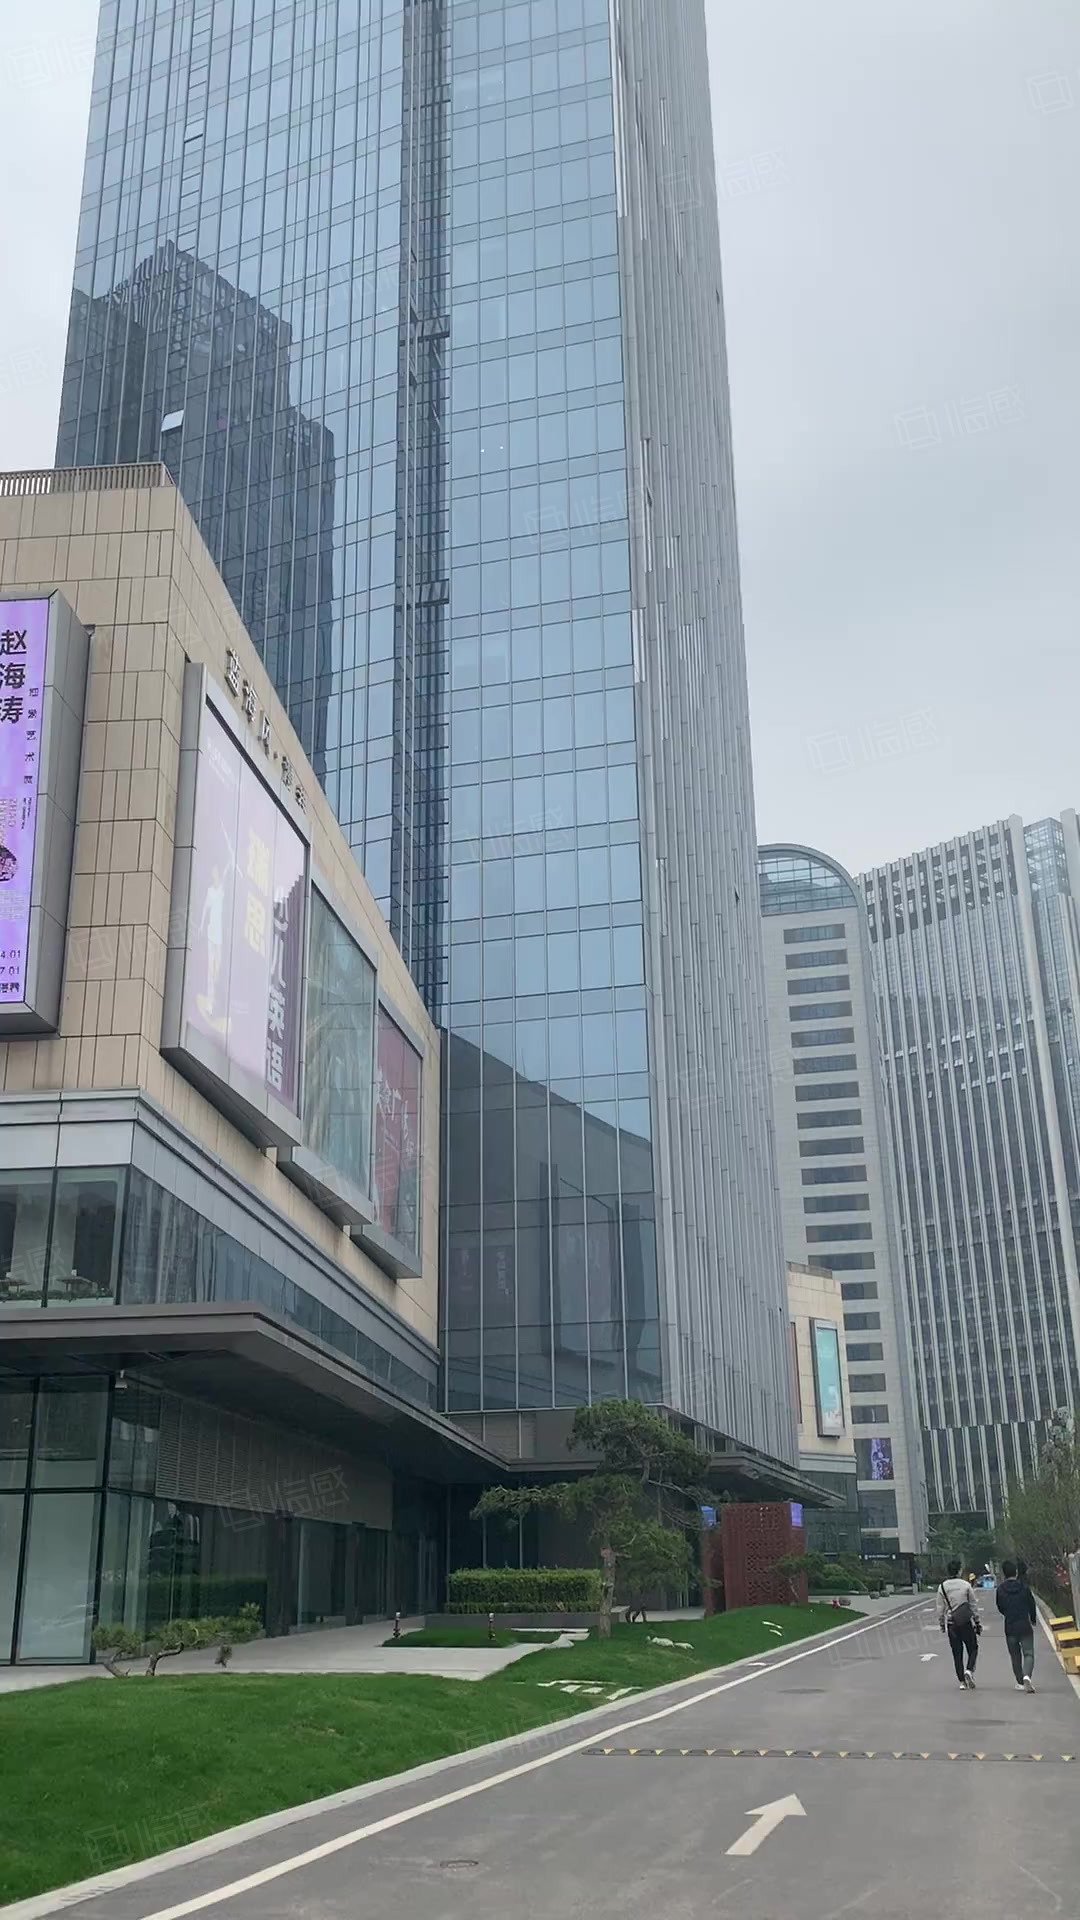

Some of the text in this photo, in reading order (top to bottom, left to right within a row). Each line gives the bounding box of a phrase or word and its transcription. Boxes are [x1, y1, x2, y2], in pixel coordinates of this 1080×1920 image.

[0, 630, 27, 724] 赵海涛
[266, 886, 288, 1092] 少儿英语
